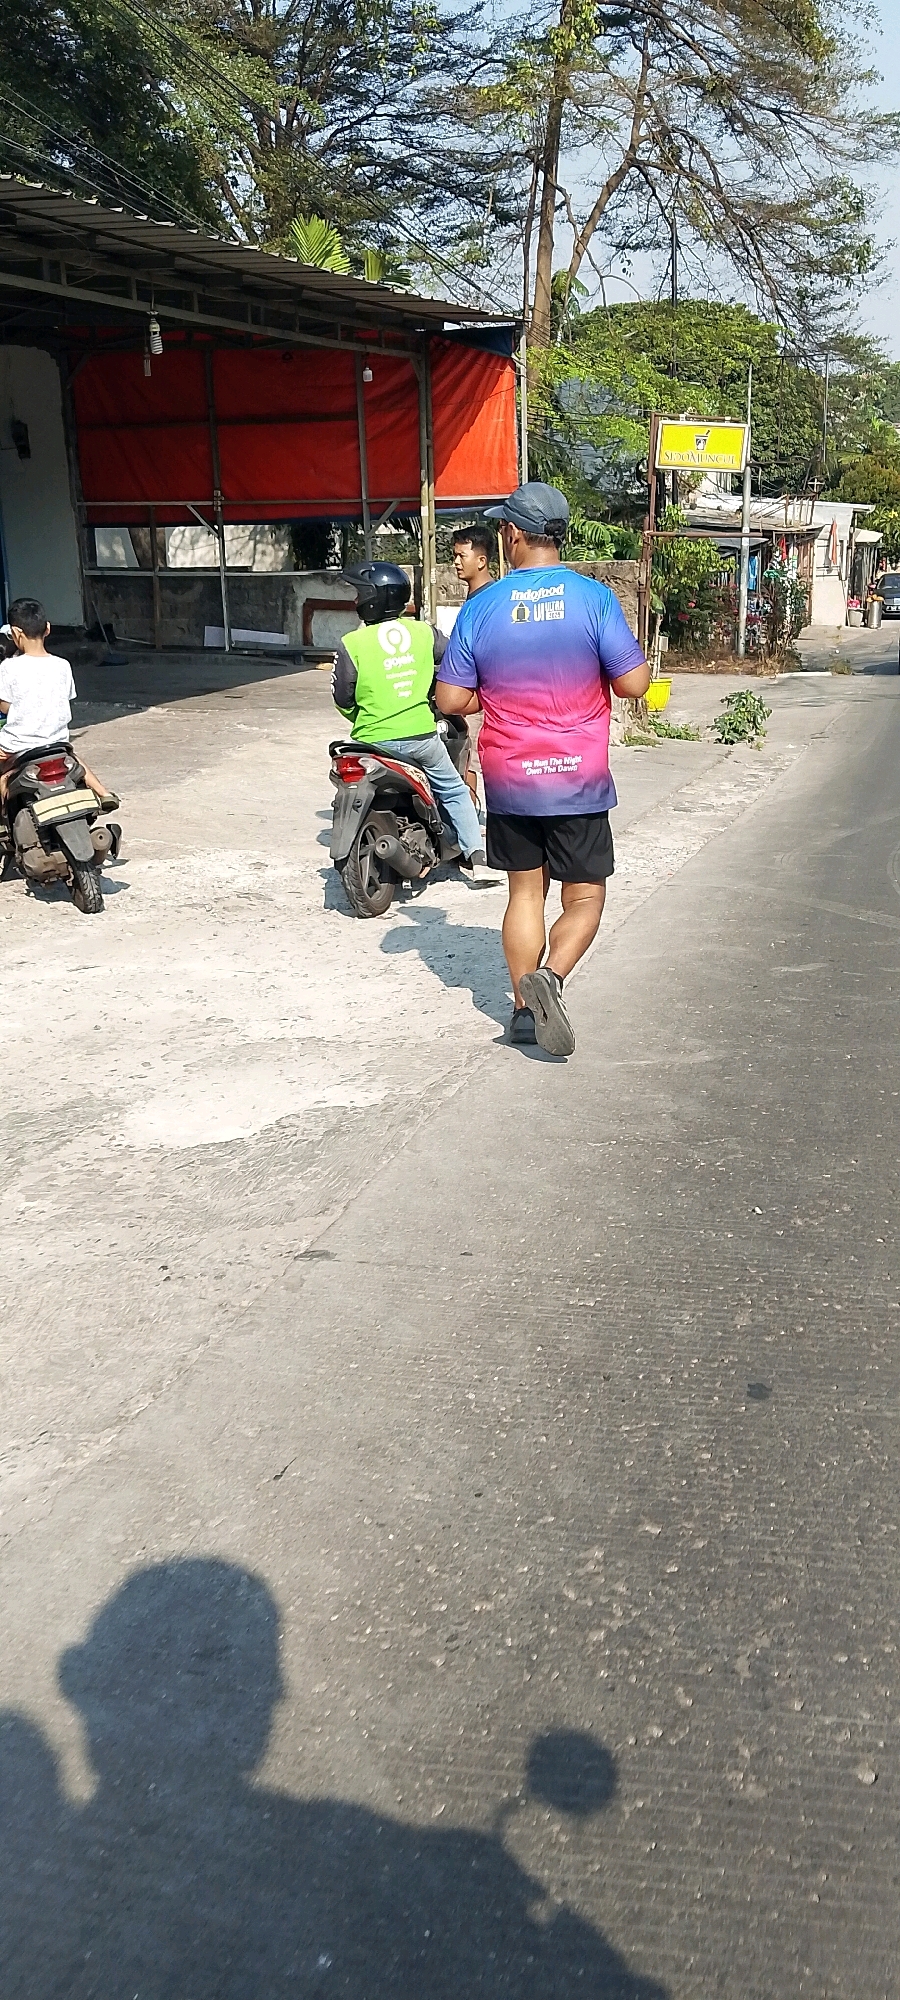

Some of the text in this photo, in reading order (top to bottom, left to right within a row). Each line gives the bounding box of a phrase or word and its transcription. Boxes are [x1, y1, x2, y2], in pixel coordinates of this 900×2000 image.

[510, 583, 565, 602] Indofood
[383, 653, 415, 671] gojek
[533, 759, 549, 767] Run
[549, 757, 563, 765] The
[526, 765, 578, 775] Own The Dawn
